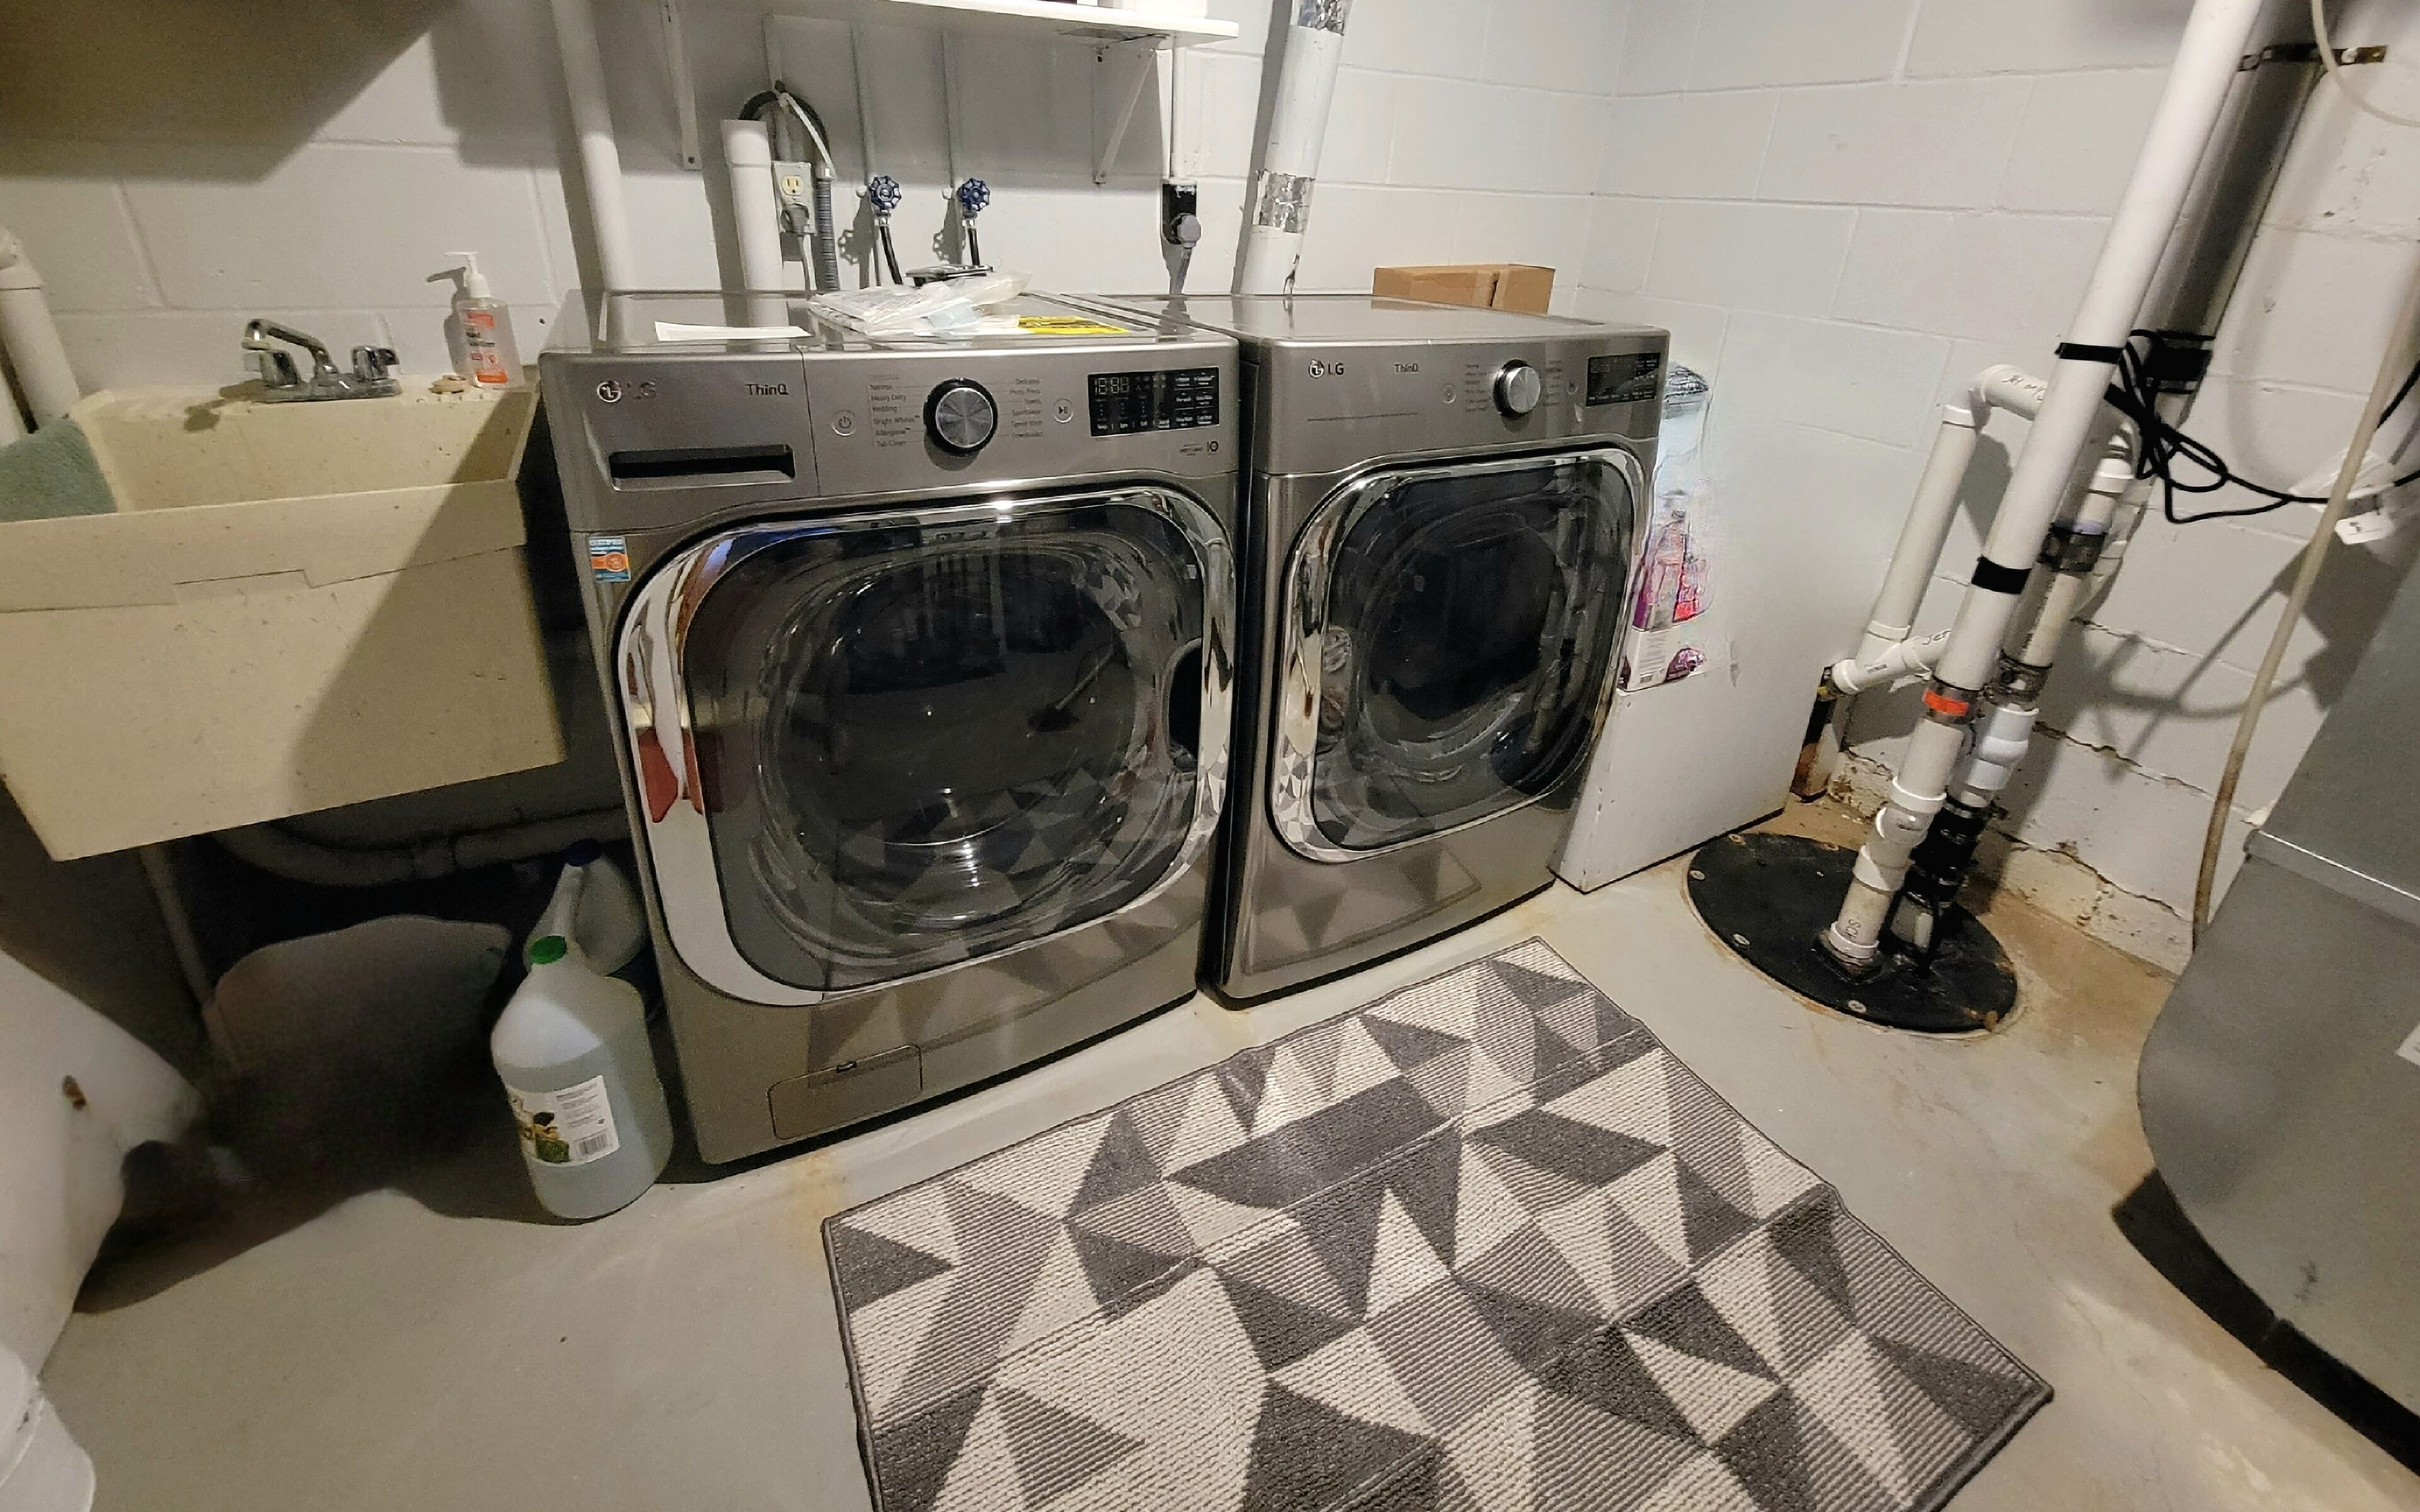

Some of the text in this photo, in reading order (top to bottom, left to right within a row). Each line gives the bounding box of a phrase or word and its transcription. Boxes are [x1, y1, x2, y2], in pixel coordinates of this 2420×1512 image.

[1328, 363, 1344, 375] LG
[745, 383, 789, 396] ThinQ
[1206, 440, 1219, 452] 10
